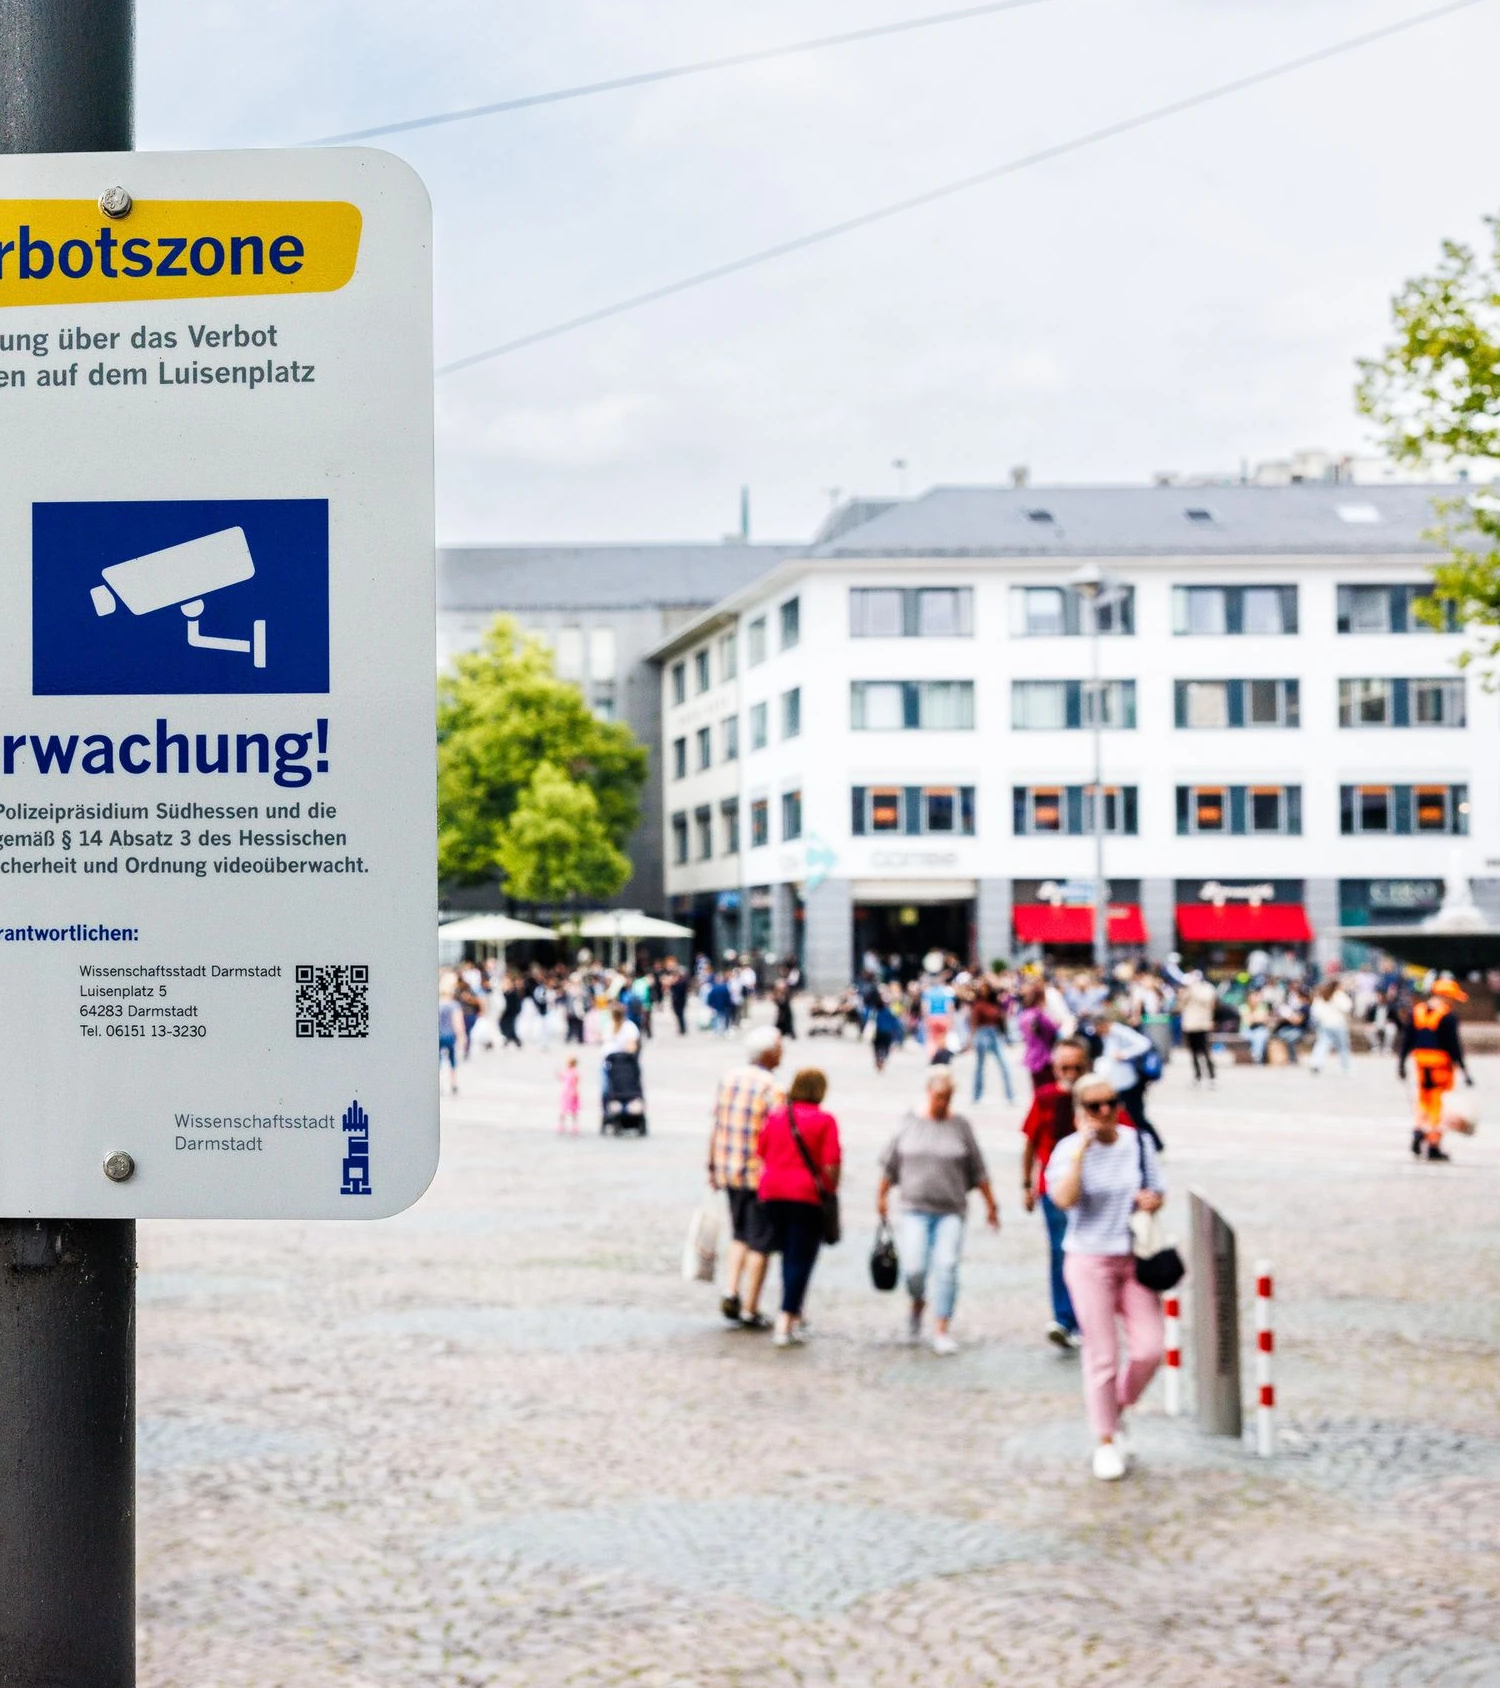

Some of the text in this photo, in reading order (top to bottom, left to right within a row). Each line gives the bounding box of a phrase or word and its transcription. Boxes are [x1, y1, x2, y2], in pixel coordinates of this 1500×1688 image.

[58, 326, 121, 351] über
[130, 325, 178, 350] das
[187, 323, 278, 350] Verbot
[36, 362, 79, 387] auf
[88, 362, 147, 386] dem
[159, 359, 316, 390] Luisenplatz
[156, 802, 259, 820] Südhessen
[265, 801, 300, 819] und
[307, 801, 337, 819] die
[61, 829, 72, 851] §
[79, 829, 103, 847] 14
[108, 829, 173, 847] Absatz
[180, 829, 192, 847] 3
[198, 829, 232, 847] des
[239, 828, 347, 847] Hessischen
[83, 856, 118, 874] und
[125, 856, 208, 878] Ordnung
[213, 856, 369, 874] videoüberwacht.
[79, 964, 282, 978] Wissenschaftsstadt Darmstadt
[80, 984, 168, 1000] Luisenplatz 5
[79, 1004, 198, 1018] 64283 Darmstadt
[79, 1024, 207, 1038] Tel. 06151 13-3230
[174, 1113, 336, 1130] Wissenschaftsstadt
[175, 1135, 263, 1152] Darmstadt
